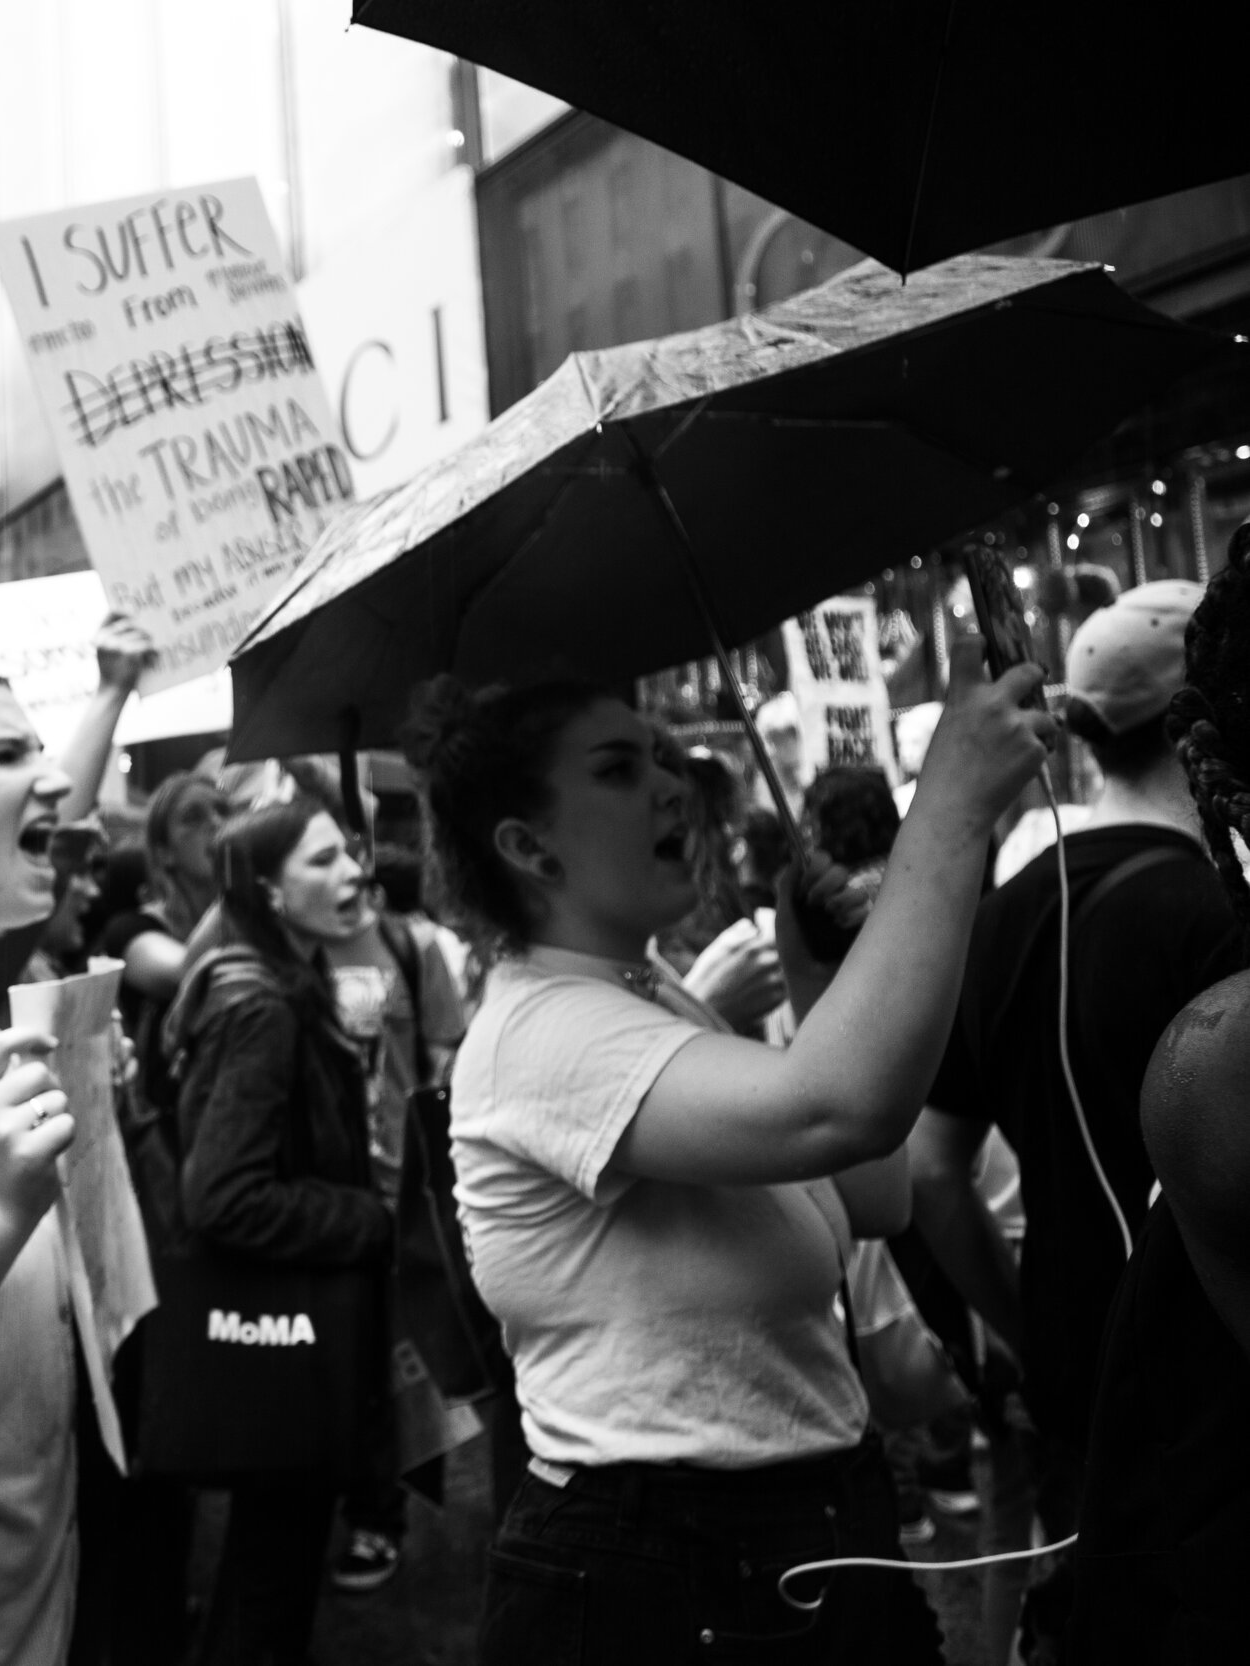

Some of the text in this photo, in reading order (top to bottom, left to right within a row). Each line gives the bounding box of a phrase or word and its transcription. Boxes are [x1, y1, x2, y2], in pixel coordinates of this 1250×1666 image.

[19, 235, 50, 309] I
[139, 397, 321, 500] TRAUMA
[207, 1308, 317, 1346] MoMA
